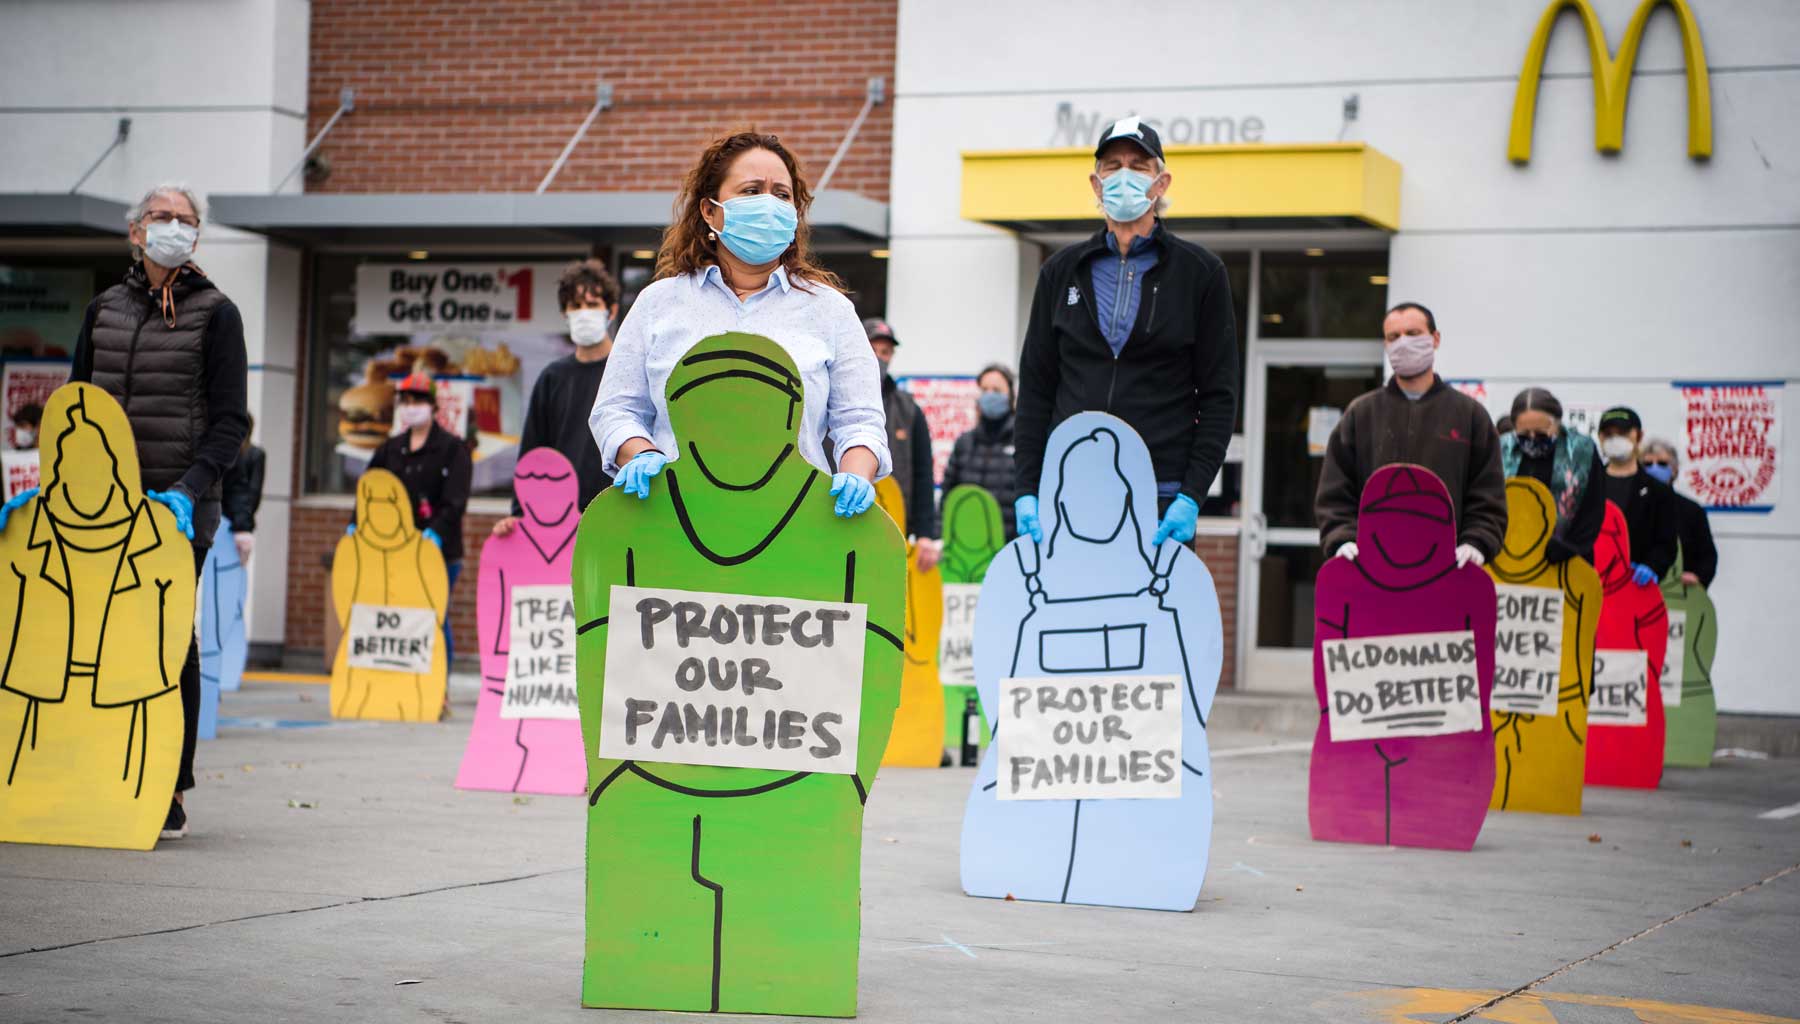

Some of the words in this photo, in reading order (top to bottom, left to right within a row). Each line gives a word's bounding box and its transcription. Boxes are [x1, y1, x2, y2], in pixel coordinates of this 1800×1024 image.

[389, 269, 437, 297] Buy
[442, 269, 499, 294] One,
[388, 298, 433, 322] Get
[440, 298, 491, 322] One
[1686, 416, 1774, 434] PROTECT
[1687, 443, 1775, 461] WORKERS
[376, 611, 401, 629] DO
[514, 598, 576, 627] TREA
[1497, 594, 1560, 623] EOPLE
[636, 597, 850, 650] PROTECT
[353, 635, 429, 663] BETTER!
[530, 629, 564, 650] US
[1496, 631, 1556, 656] VER
[514, 654, 574, 679] LIKE
[1326, 638, 1476, 673] McDONALDS
[675, 656, 783, 696] OUR
[1493, 666, 1560, 694] ROFIT
[508, 683, 578, 706] HUMAN
[1010, 681, 1175, 719] PROTECT
[1334, 690, 1374, 716] DO
[1375, 674, 1481, 711] BETTER
[1595, 672, 1646, 715] TER!
[625, 697, 843, 759] FAMILIES
[1053, 715, 1132, 744] OUR
[1010, 750, 1175, 794] FAMILIES
